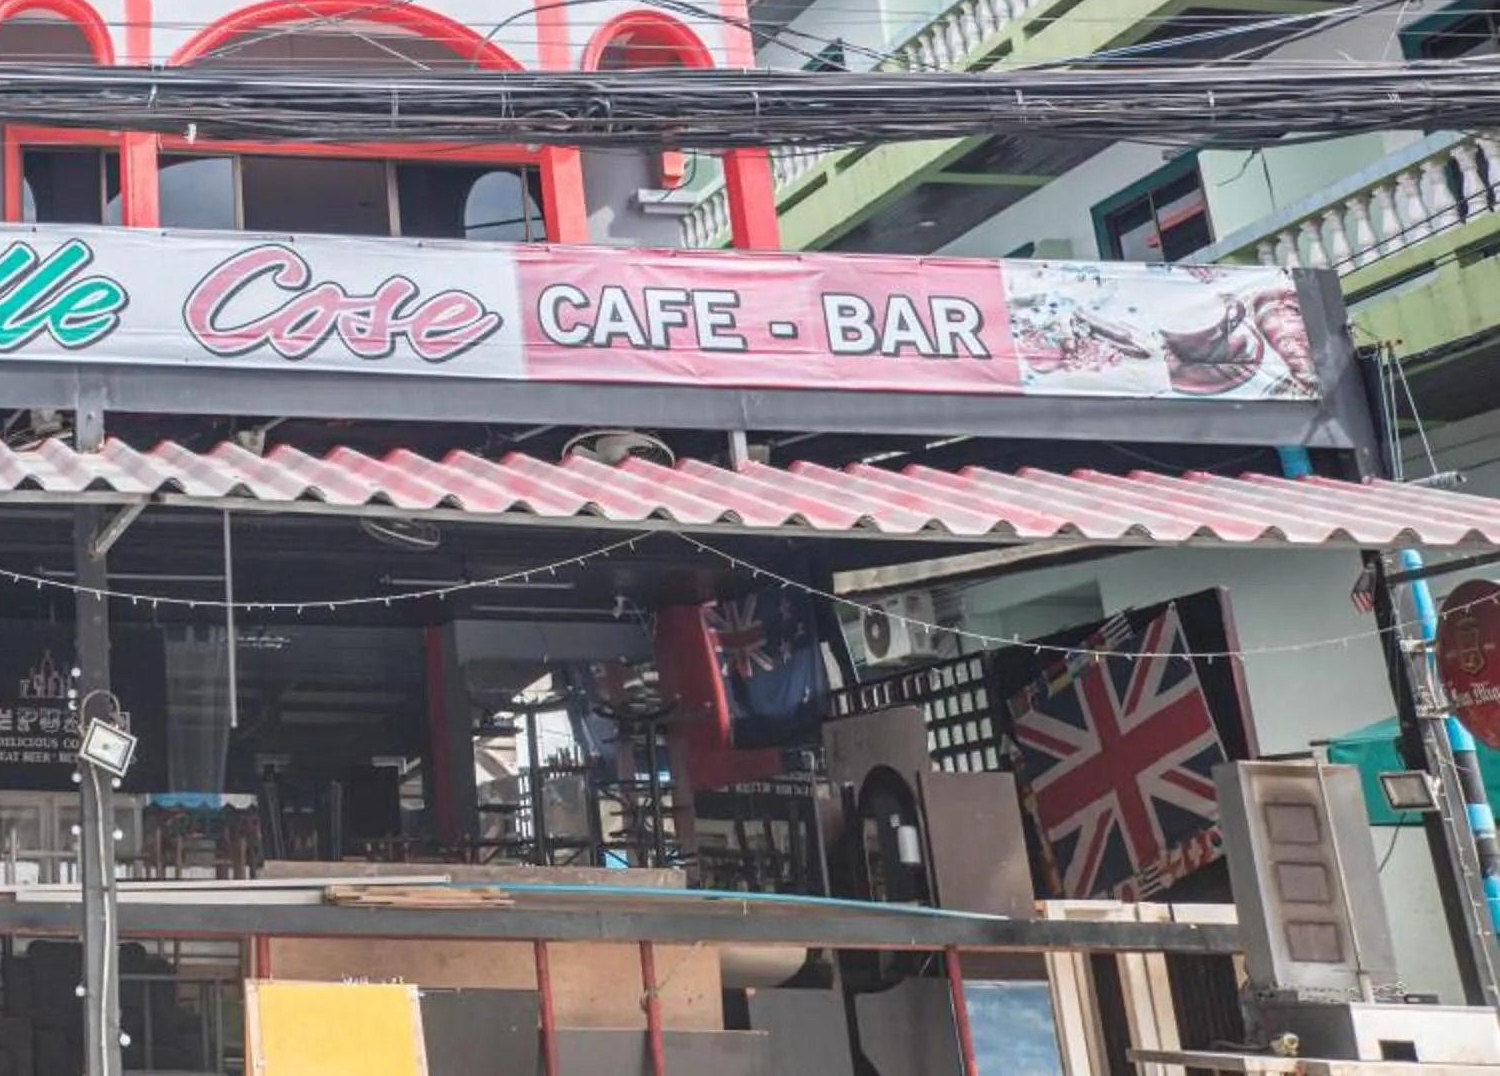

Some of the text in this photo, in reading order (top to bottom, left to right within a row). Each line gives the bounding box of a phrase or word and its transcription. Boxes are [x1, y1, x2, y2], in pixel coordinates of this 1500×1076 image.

[182, 243, 503, 362] Cose
[536, 283, 747, 352] CAFE
[820, 292, 991, 359] BAR
